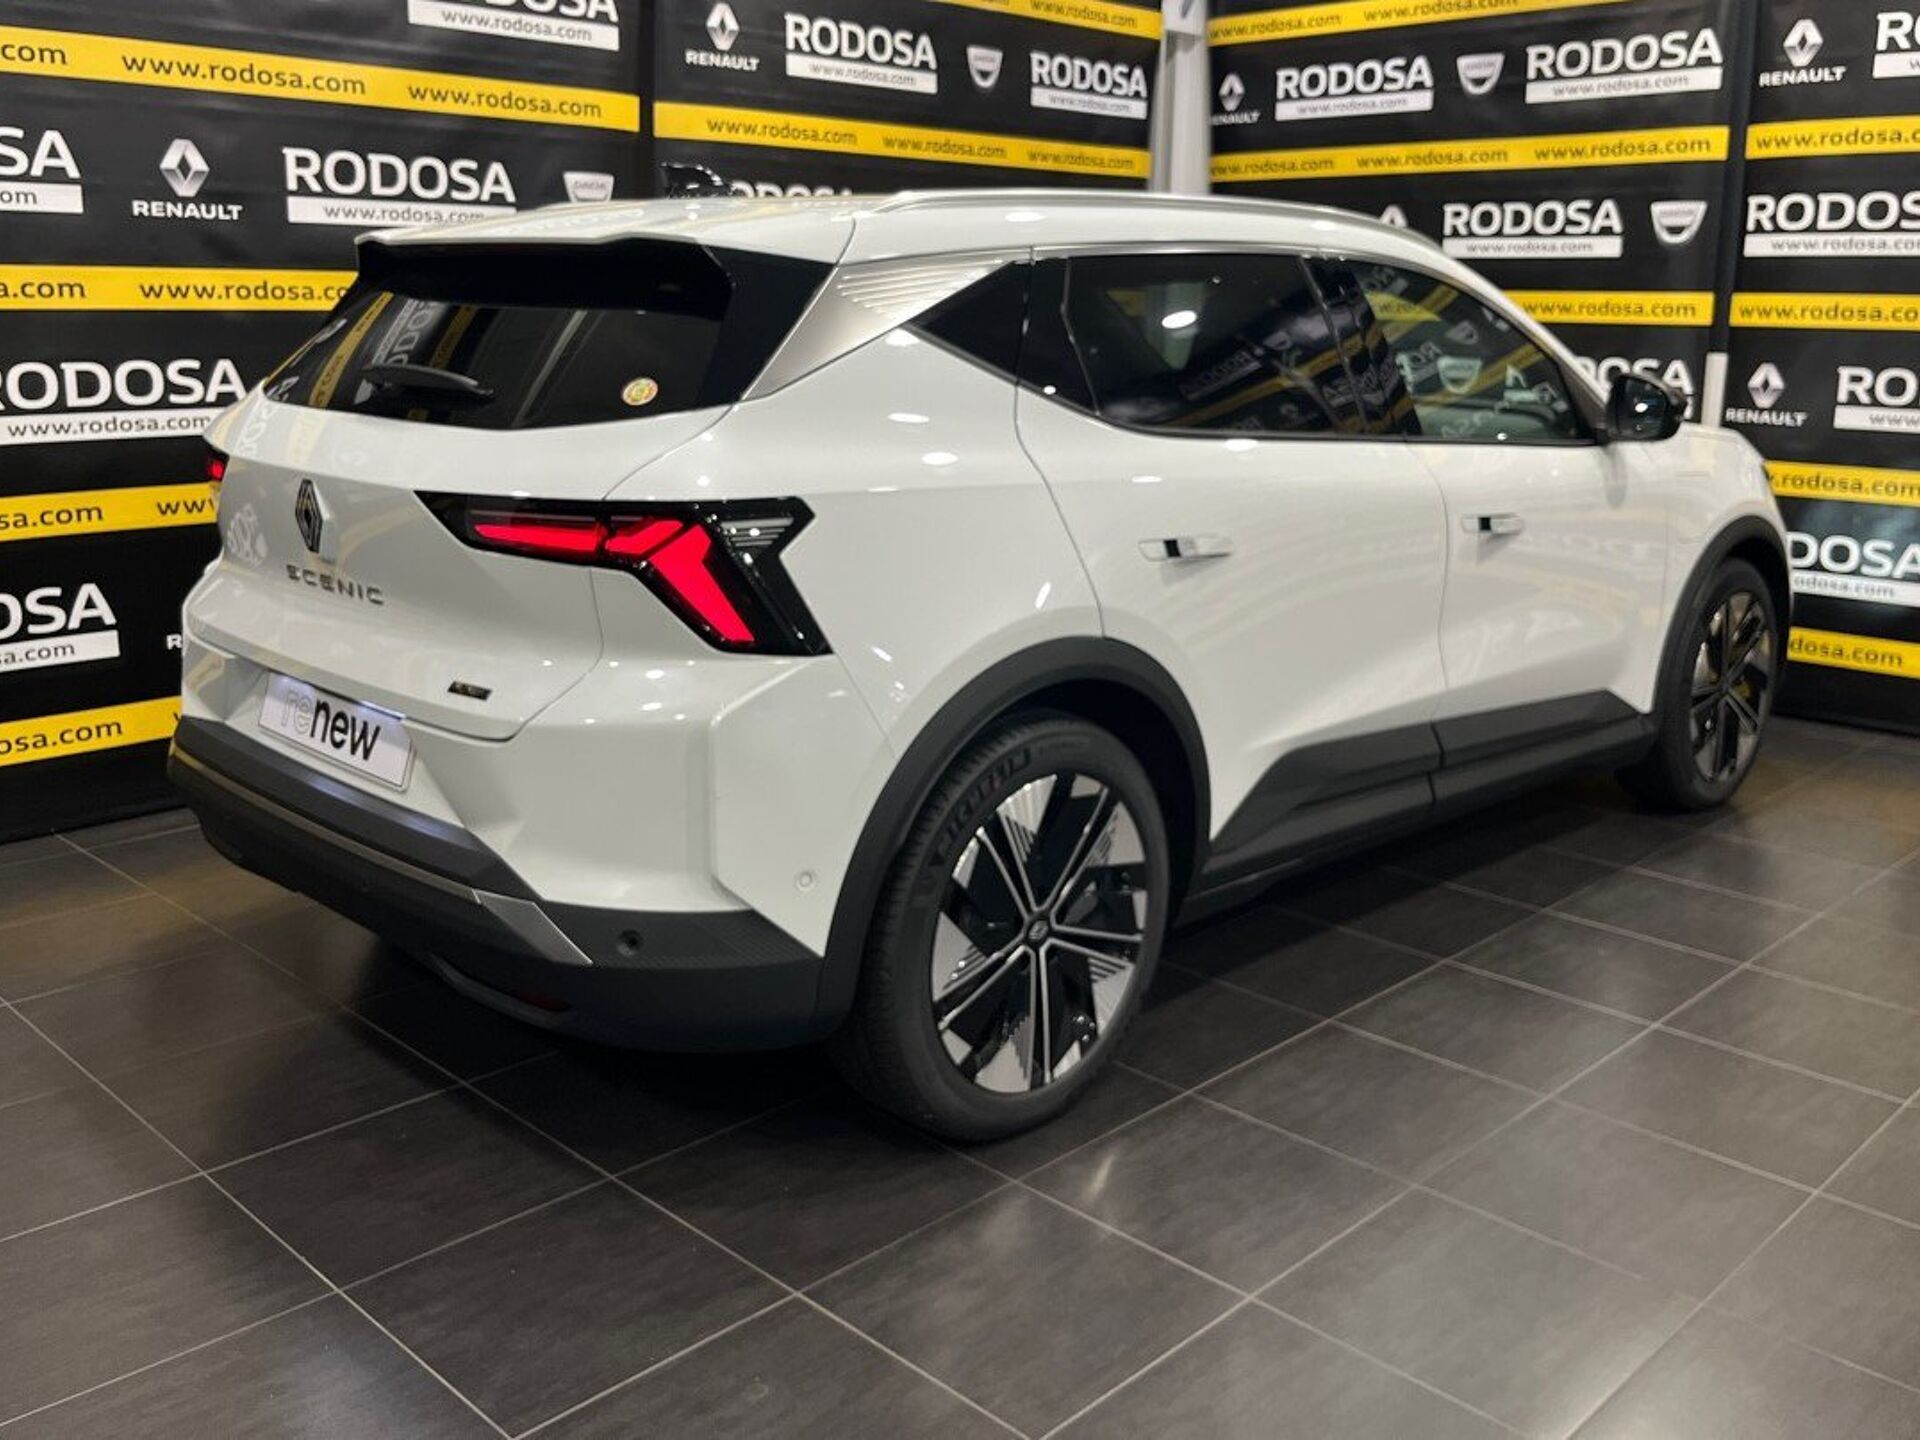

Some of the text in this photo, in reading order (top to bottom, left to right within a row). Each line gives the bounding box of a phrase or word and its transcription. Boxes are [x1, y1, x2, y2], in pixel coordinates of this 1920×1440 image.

[441, 10, 592, 41] www.rodosa.com
[1876, 11, 1920, 51] R
[785, 12, 937, 70] RODOSA
[1525, 28, 1723, 80] RODOSA
[122, 54, 366, 95] www.rodosa.com
[685, 49, 760, 71] RENAULT
[1030, 51, 1148, 98] RODOSA
[809, 63, 918, 87] www.rodosa.com
[1275, 55, 1434, 100] RODOSA
[1552, 73, 1689, 97] www.rodosa.com
[1759, 66, 1847, 88] RENAULT
[408, 84, 602, 118] www.rodosa.com
[706, 118, 858, 146] www.rodosa.com
[882, 134, 1007, 159] www.rodosa.com
[1027, 149, 1134, 170] www.rodosa.com
[1356, 150, 1508, 170] www.rodosa.com
[1534, 136, 1711, 161] www.rodosa.com
[282, 146, 516, 203] RODOSA
[132, 200, 243, 220] RENAULT
[1442, 199, 1623, 237] RODOSA
[1522, 299, 1697, 319] www.rodosa.com
[1739, 303, 1918, 322] www.rodosa.co
[0, 358, 248, 411] ODOSA
[1725, 407, 1808, 428] RENAULT
[287, 564, 384, 606] SCENIC
[281, 686, 381, 761] renew
